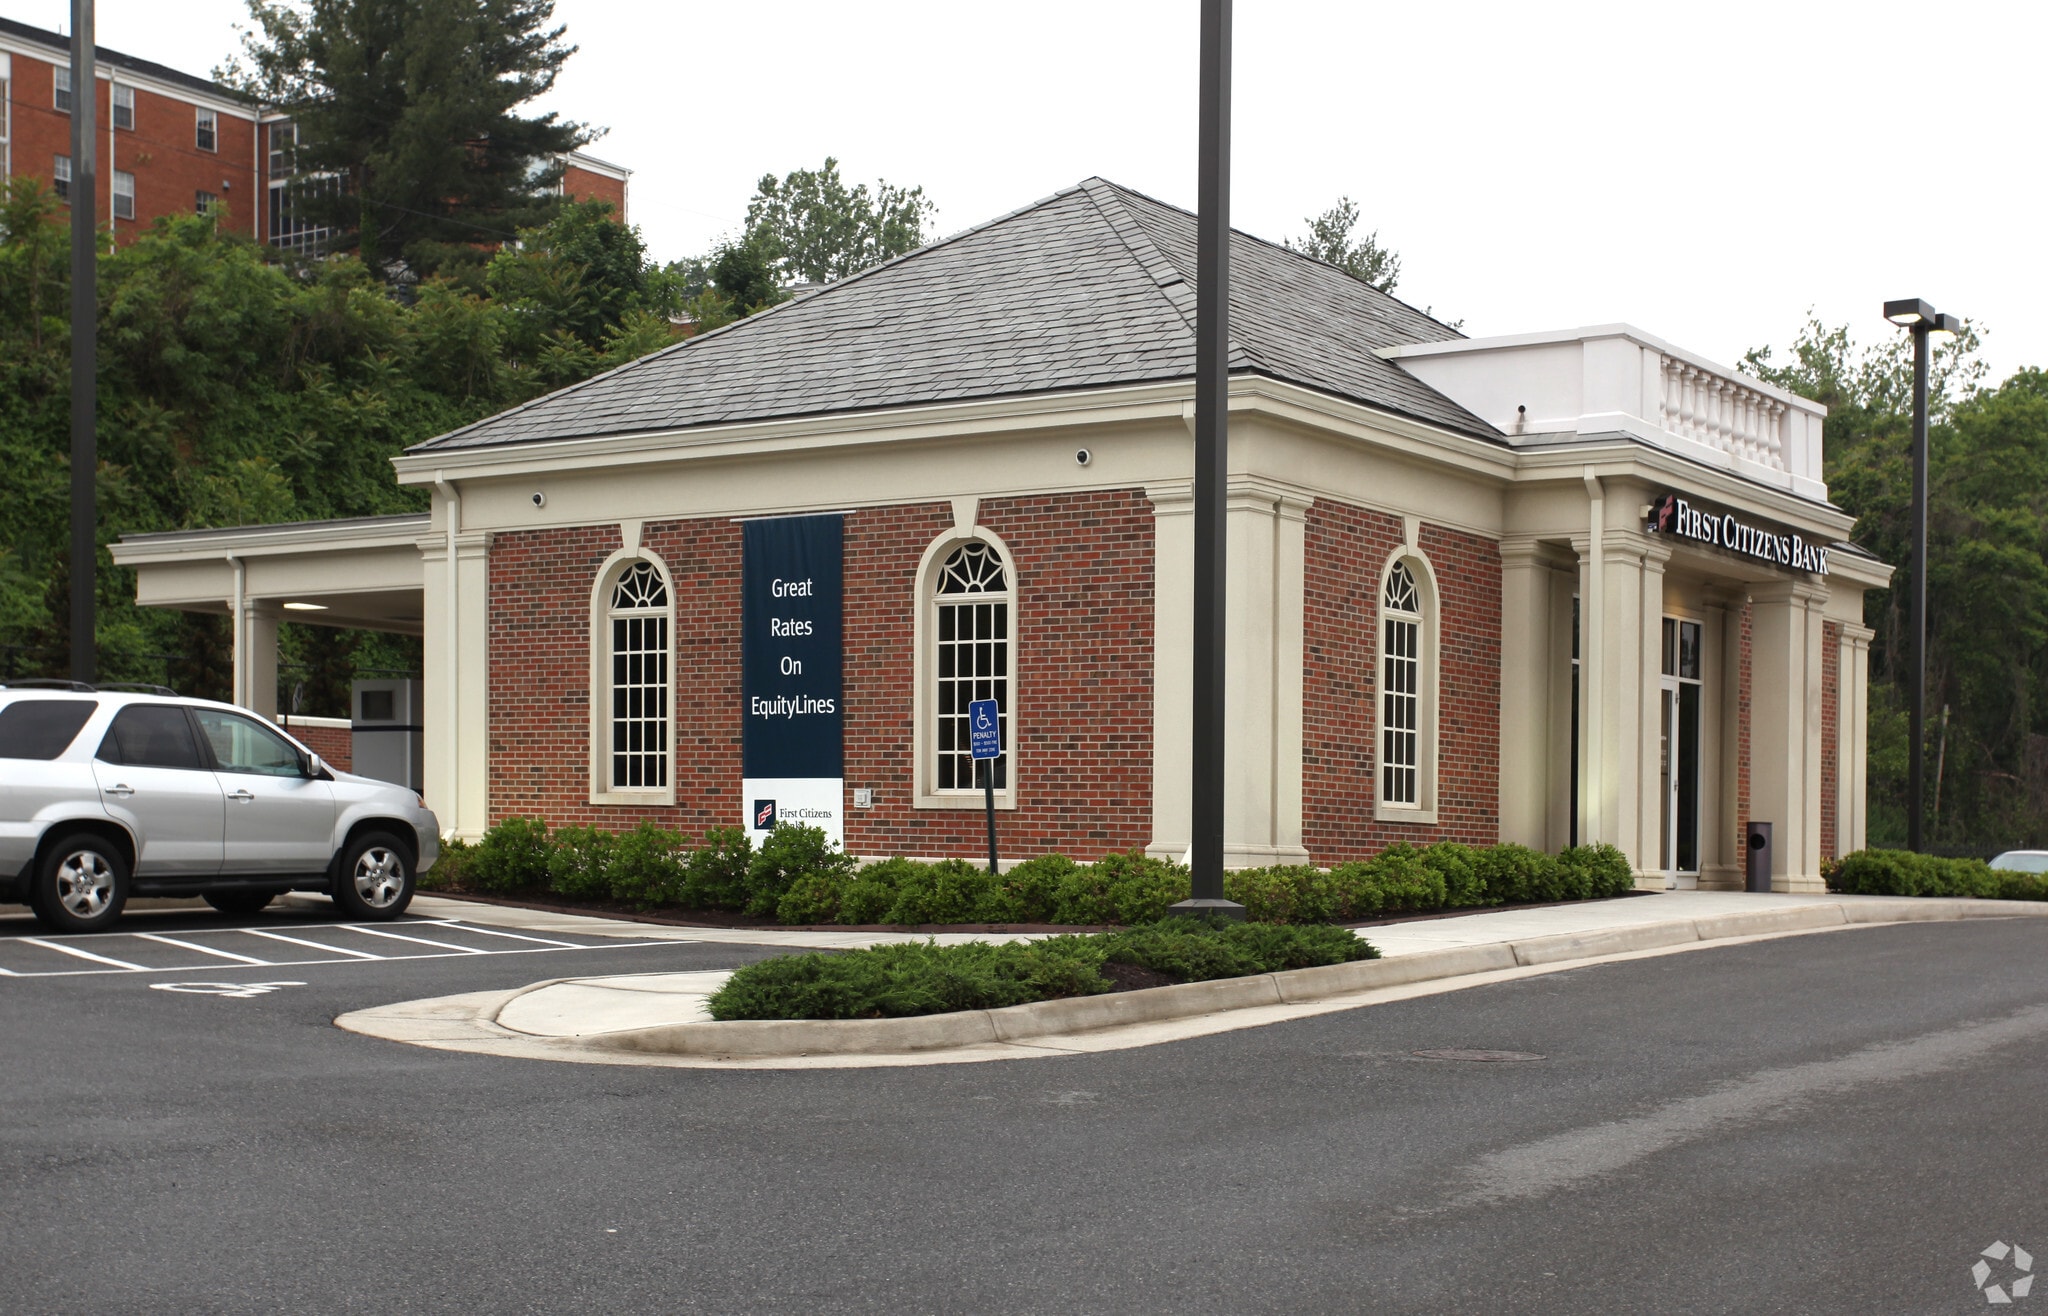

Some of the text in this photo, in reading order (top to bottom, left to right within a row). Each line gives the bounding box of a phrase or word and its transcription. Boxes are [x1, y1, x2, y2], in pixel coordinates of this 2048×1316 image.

[1676, 499, 1829, 575] FIRST CITIZENS BANK
[771, 578, 813, 598] Great
[771, 617, 813, 637] Rates
[780, 656, 802, 676] On
[751, 694, 835, 720] EquityLines
[973, 731, 996, 739] PENALTY
[779, 808, 832, 818] First Citizens
